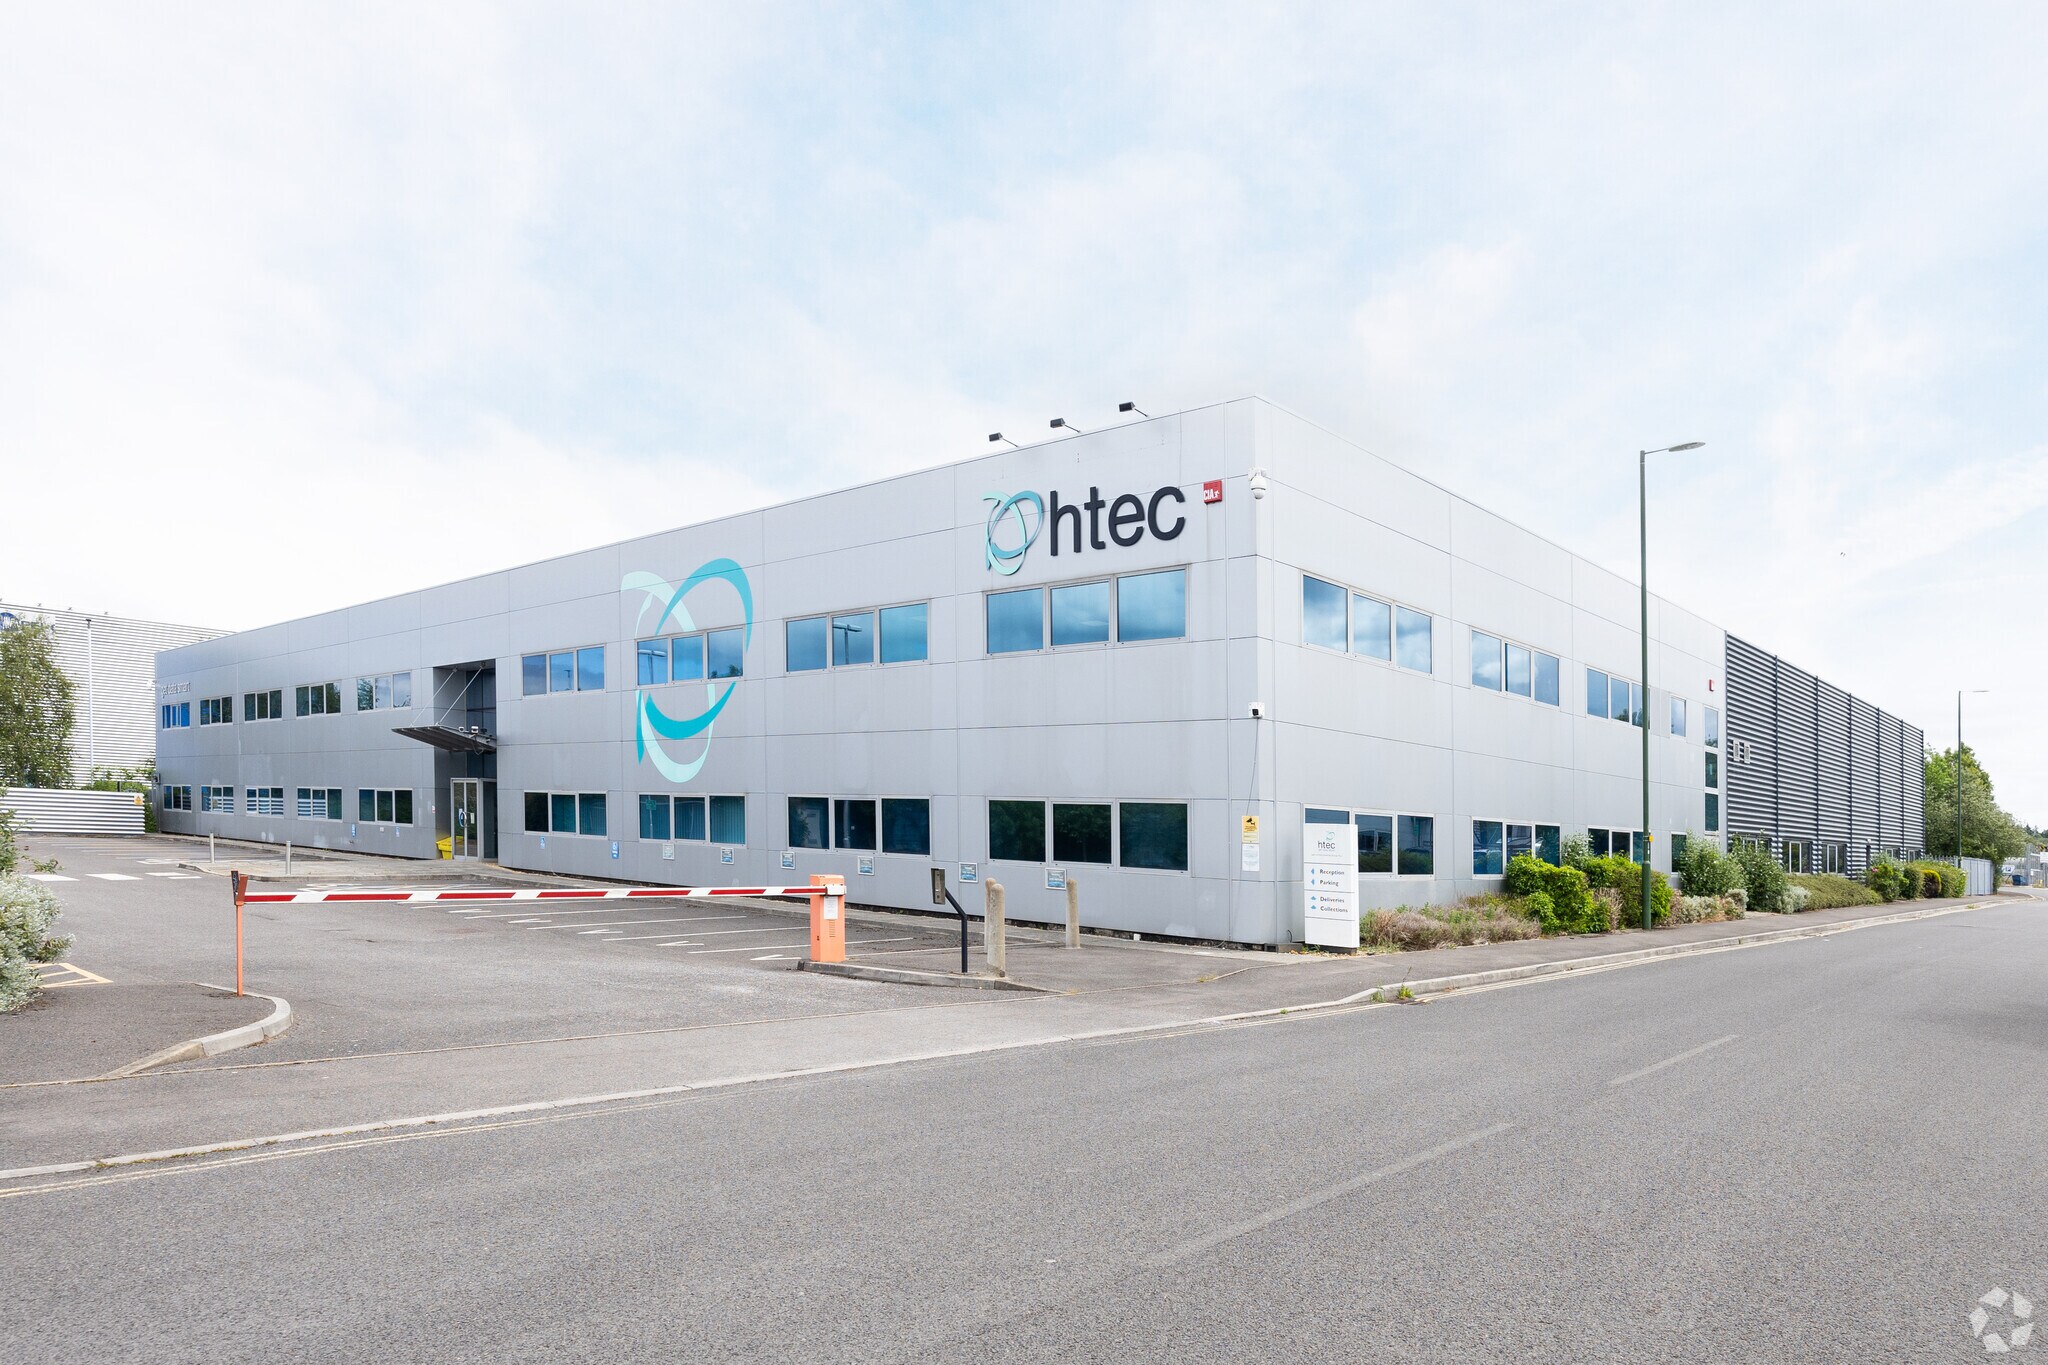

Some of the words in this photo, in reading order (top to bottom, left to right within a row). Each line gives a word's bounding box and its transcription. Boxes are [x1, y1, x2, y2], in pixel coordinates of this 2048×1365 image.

[1050, 486, 1186, 556] htec
[1317, 840, 1336, 849] htec
[1319, 879, 1339, 887] Parking
